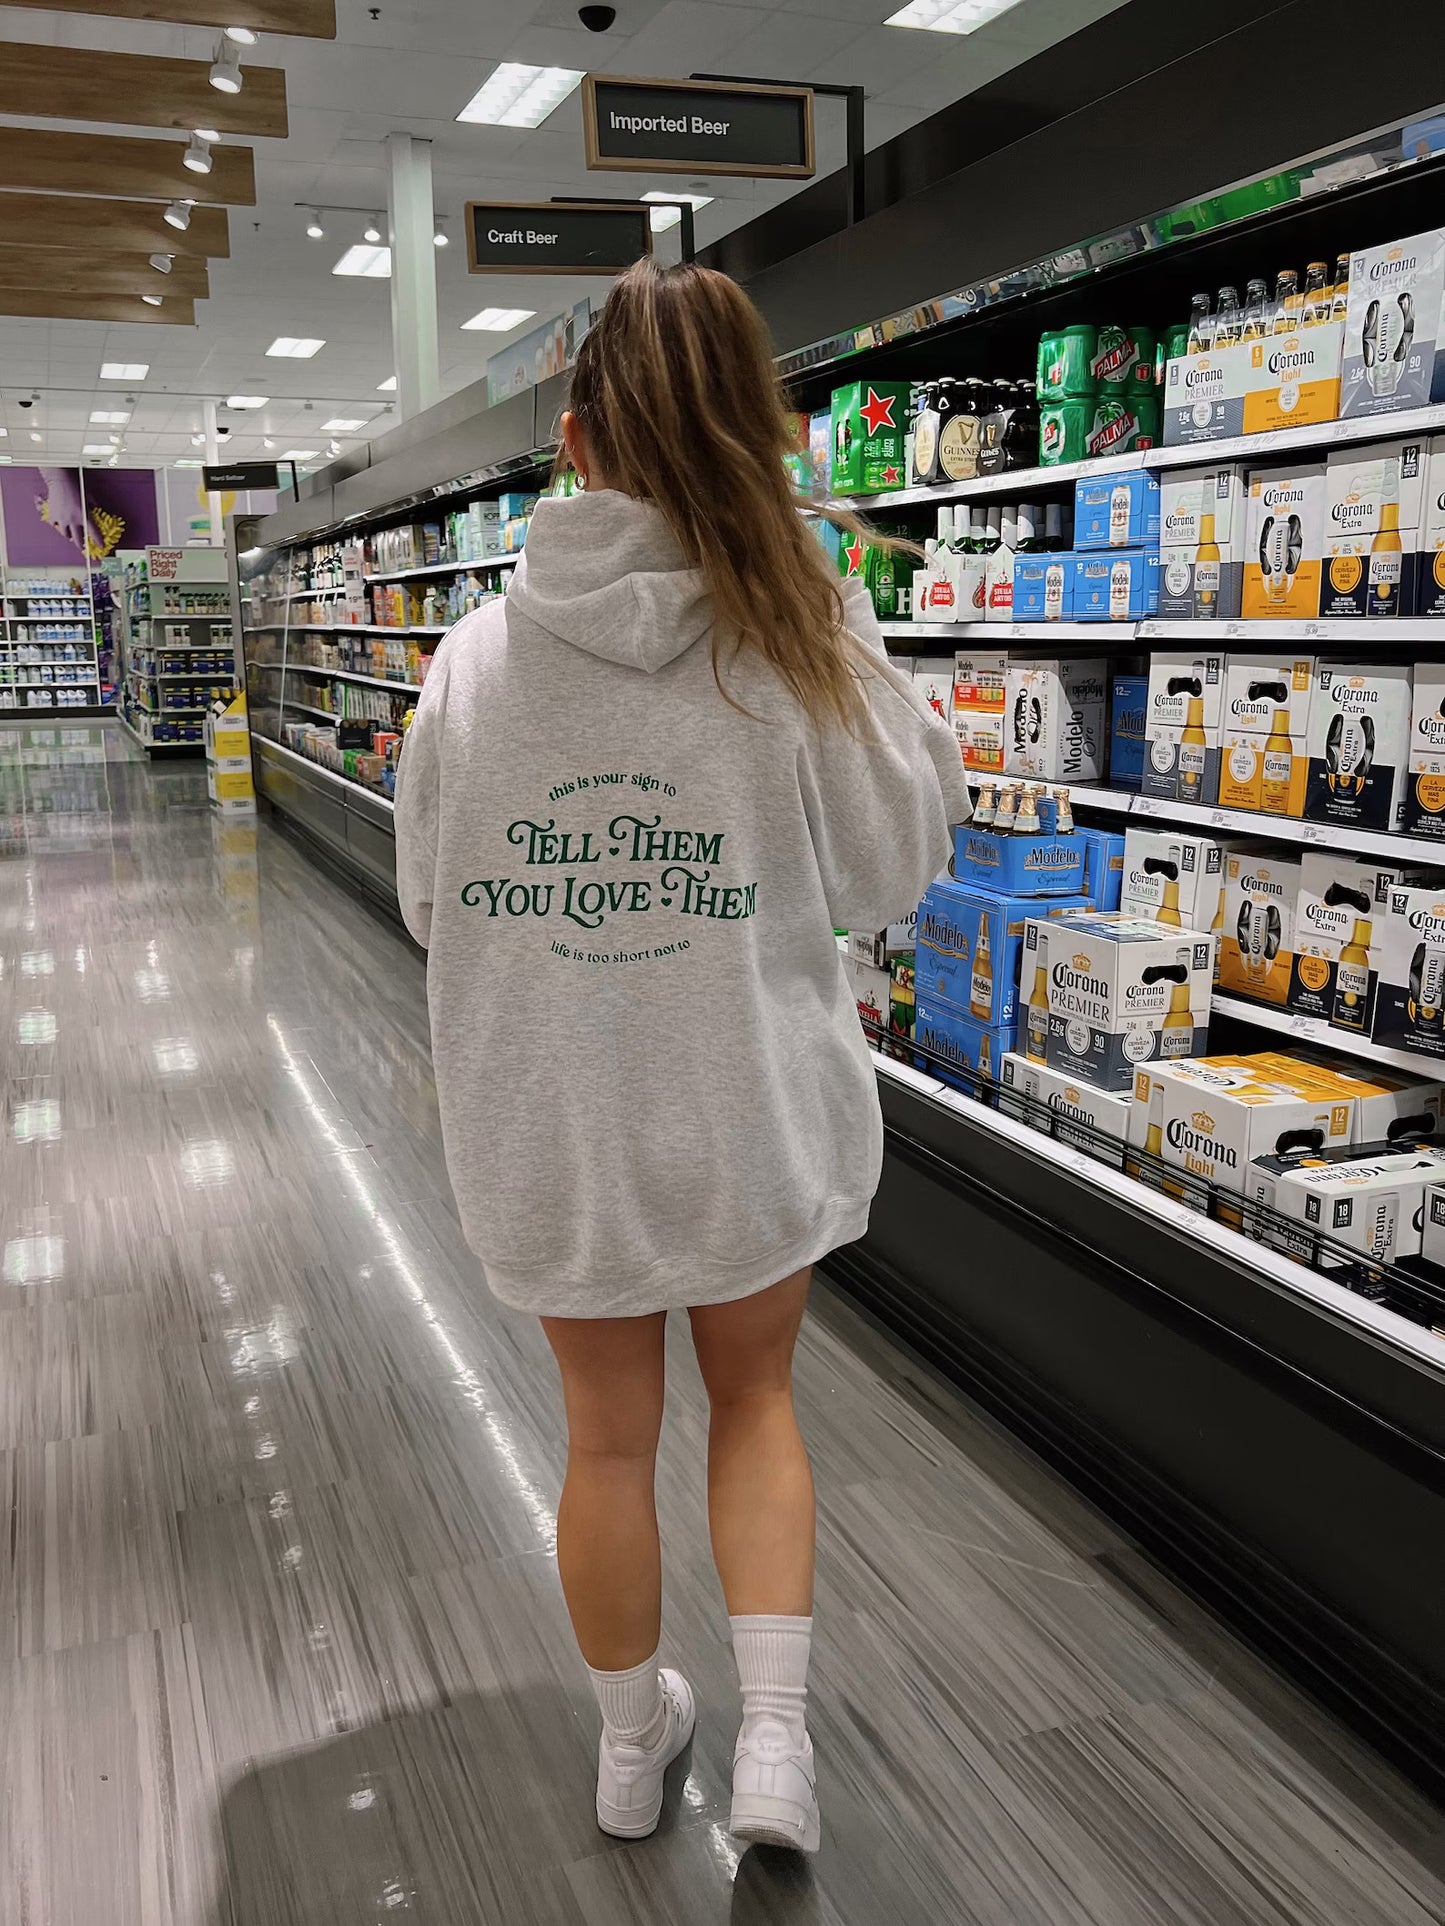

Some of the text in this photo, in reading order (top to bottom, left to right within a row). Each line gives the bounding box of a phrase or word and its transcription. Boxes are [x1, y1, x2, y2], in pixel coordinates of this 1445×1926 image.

[610, 111, 730, 136] Imported Beer
[487, 229, 558, 245] Craft Beer
[1369, 257, 1416, 281] Corona
[1378, 313, 1389, 362] Corona
[1096, 344, 1134, 379] PALMA
[1268, 350, 1314, 375] Corona
[1410, 356, 1421, 368] 90
[1185, 368, 1223, 387] Corona
[1185, 384, 1224, 400] PREMIER
[1091, 415, 1132, 454] PALMA
[1406, 448, 1417, 464] 12
[1148, 481, 1159, 490] 12
[1219, 474, 1228, 486] 12
[1264, 489, 1304, 508] Corona
[1331, 502, 1373, 522] Corona
[1165, 514, 1195, 528] Corona
[1339, 518, 1362, 529] Extra
[1164, 528, 1196, 538] PREMIER
[150, 550, 183, 559] Priced
[1273, 529, 1283, 573] Corona
[151, 559, 177, 569] Right
[1148, 558, 1159, 566] 12
[1371, 561, 1399, 574] Corona
[151, 568, 176, 579] Daily
[1375, 572, 1393, 581] Extra
[958, 660, 973, 670] Modelo
[1209, 660, 1218, 673] 12
[1297, 663, 1306, 678] 12
[1322, 672, 1330, 683] 12
[1115, 686, 1124, 696] 12
[1332, 684, 1378, 703] Corona
[1154, 694, 1183, 707] Corona
[1231, 699, 1268, 717] Corona
[1339, 702, 1365, 714] Extra
[1154, 707, 1183, 718] PREMIER
[1240, 714, 1257, 724] Light
[1419, 717, 1445, 735] Cor
[1063, 710, 1084, 774] Modelo
[1083, 727, 1097, 757] Oro
[1181, 751, 1203, 764] Corona
[1341, 729, 1354, 772] Corona
[1265, 759, 1290, 772] Corona
[549, 772, 676, 801] this is your sign to
[507, 815, 725, 865] TELL THEM
[968, 838, 997, 860] Modelo
[1185, 848, 1193, 860] 12
[1210, 850, 1219, 862] 12
[1032, 848, 1077, 866] Modelo
[1129, 870, 1159, 887] Corona
[1240, 875, 1283, 896] Corona
[1380, 875, 1390, 889] 12
[1128, 886, 1159, 898] PREMIER
[461, 879, 554, 917] YOU
[562, 877, 652, 929] LOVE
[1395, 895, 1405, 907] 12
[1306, 903, 1347, 924] Corona
[925, 913, 964, 950] Modelo
[1028, 926, 1037, 939] 12
[1313, 919, 1336, 932] Extra
[1250, 916, 1262, 955] Corona
[550, 939, 691, 964] life is too short not to
[1197, 945, 1207, 958] 12
[1303, 966, 1324, 974] CERVEZA
[1339, 970, 1366, 985] Corona
[973, 974, 992, 993] Modelo
[1052, 962, 1109, 1000] Corona
[1423, 959, 1439, 1004] Corona
[1126, 985, 1165, 1000] Corona
[1051, 989, 1111, 1023] PREMIER
[1125, 997, 1165, 1009] PREMIER
[918, 1006, 926, 1017] 12
[1003, 1003, 1013, 1020] 12
[1050, 1018, 1064, 1037] 2.6g
[1094, 1034, 1105, 1049] 90
[1163, 1035, 1191, 1048] Corona
[1138, 1075, 1148, 1089] 12
[1048, 1092, 1095, 1126] Corona
[1334, 1108, 1346, 1123] 12
[1166, 1118, 1238, 1170] Corona
[1184, 1150, 1216, 1178] Light
[1304, 1165, 1380, 1183] Corona
[1309, 1201, 1318, 1213] 18
[1338, 1204, 1349, 1218] 18
[1435, 1201, 1445, 1215] 18
[1371, 1204, 1387, 1260] Corona
[1383, 1218, 1394, 1251] Extra
